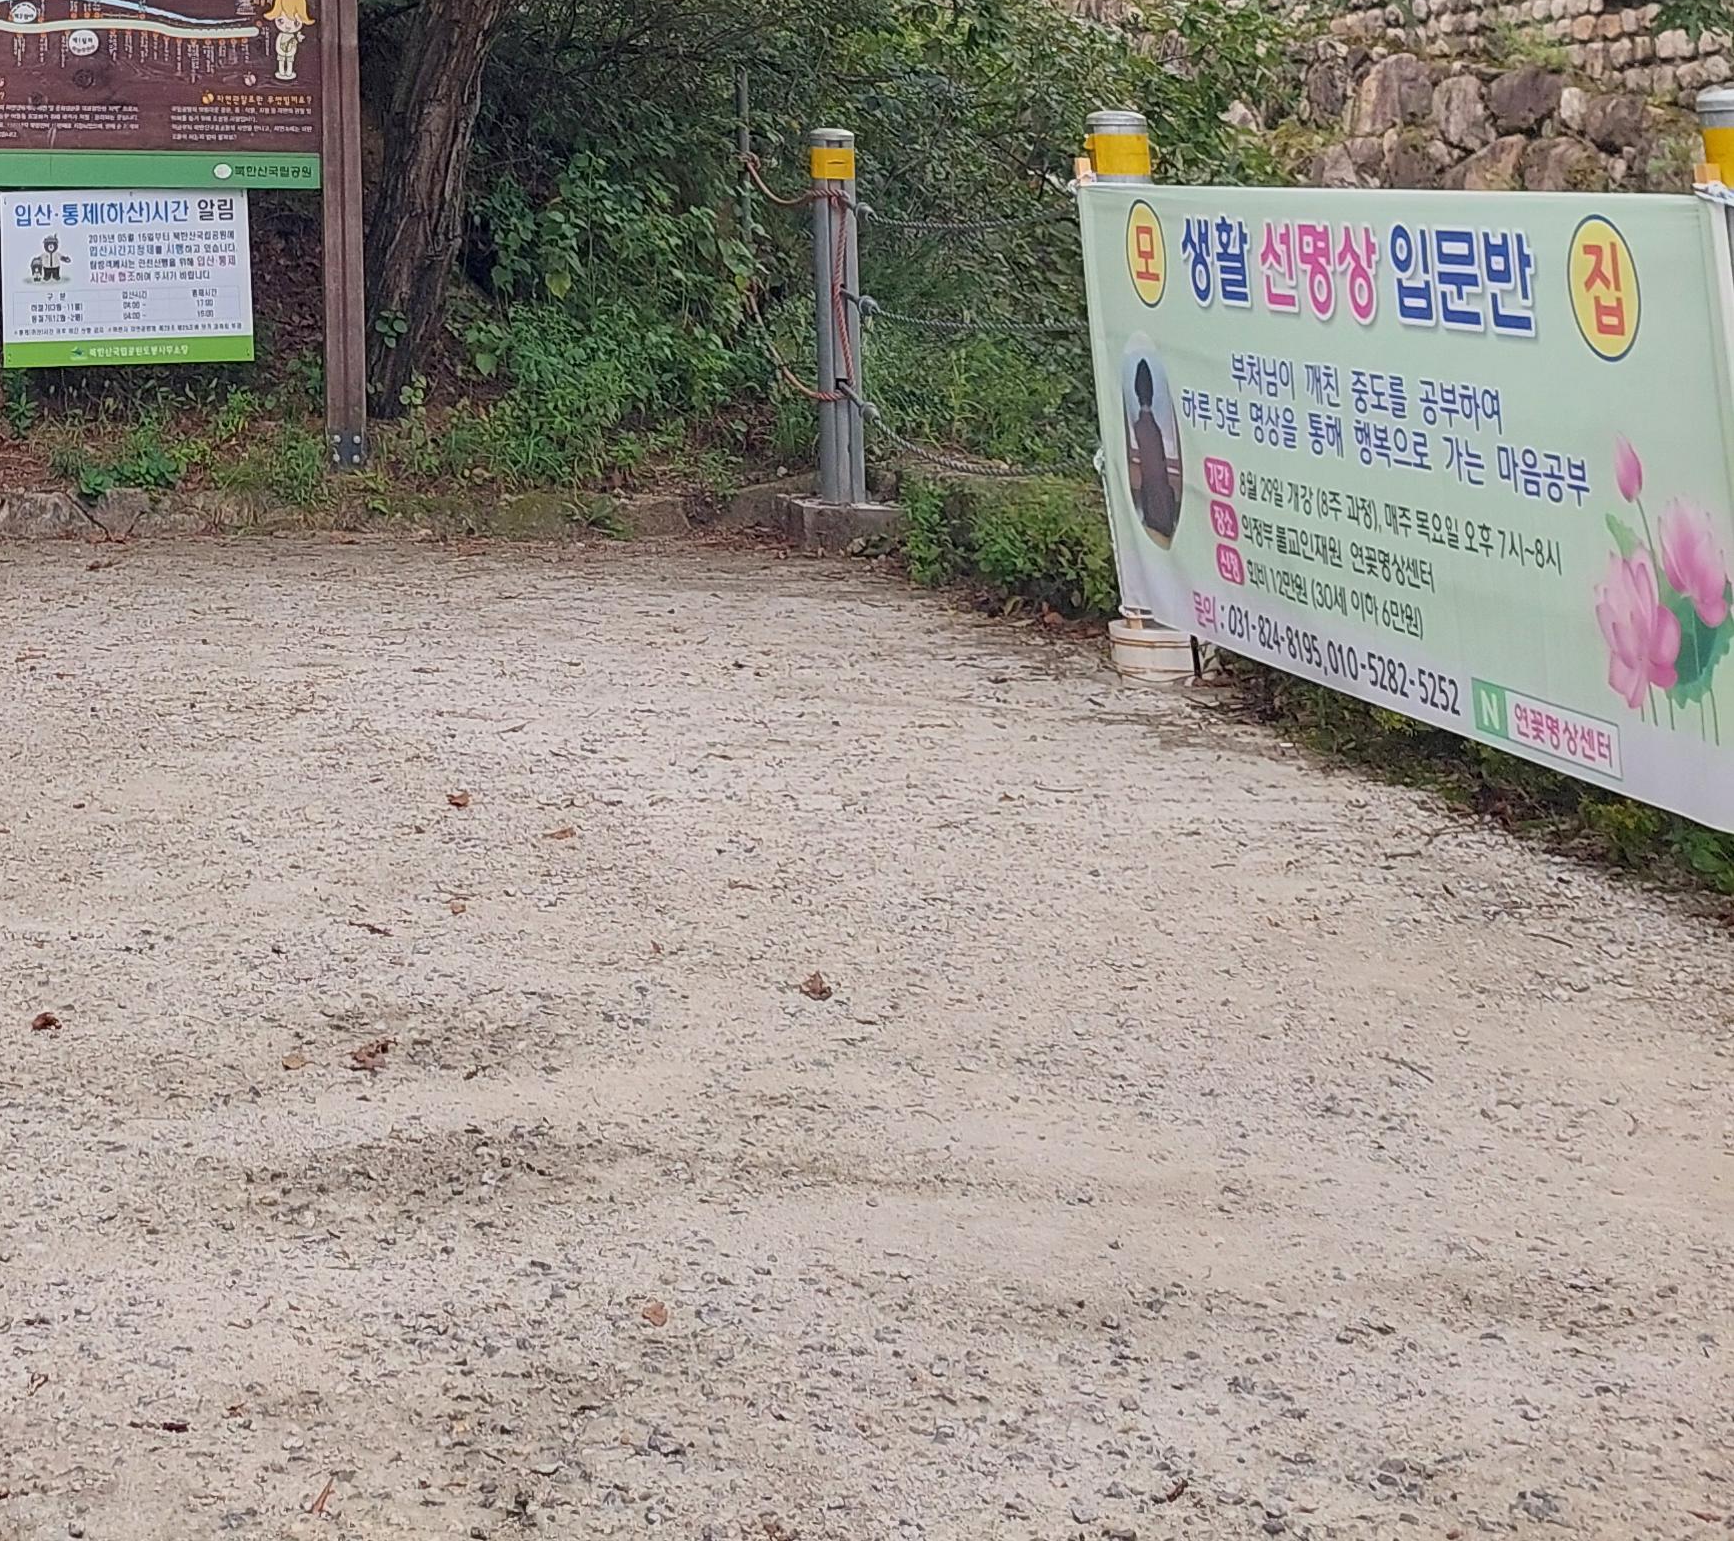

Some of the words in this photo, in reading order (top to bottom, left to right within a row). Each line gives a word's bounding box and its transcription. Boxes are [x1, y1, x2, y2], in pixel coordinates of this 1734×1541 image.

[235, 165, 312, 178] 북한산국립공원
[197, 198, 234, 221] 알림
[1135, 224, 1161, 283] 모
[1181, 215, 1250, 304] 생활
[1260, 221, 1378, 323] 선명상
[1389, 223, 1535, 334] 입문반
[1582, 240, 1627, 338] 집
[1231, 352, 1296, 401] 부처님이
[1304, 363, 1342, 409] 깨친
[1351, 370, 1408, 419] 중도를
[1419, 380, 1503, 435] 공부하여
[1181, 388, 1213, 433] 하루
[1215, 397, 1240, 438] 5분
[1249, 402, 1298, 450] 명상을
[1307, 412, 1345, 459] 통해
[1354, 420, 1433, 473] 행복으로
[1442, 436, 1486, 487] 가는
[1496, 444, 1591, 508] 마음공부
[1206, 462, 1230, 495] 기간
[1239, 470, 1257, 501] 8월
[1260, 476, 1284, 508] 29일
[1287, 482, 1314, 516] 개강
[1384, 502, 1412, 538] 매주
[1416, 510, 1460, 550] 목요일
[1465, 520, 1494, 558] 오후
[1213, 505, 1236, 537] 장소
[1350, 542, 1435, 593] 연꽃명상센터
[1192, 589, 1218, 633] 문의
[1268, 567, 1309, 605] 12만원
[1350, 590, 1378, 626] 이하
[1481, 692, 1502, 731] N
[1514, 702, 1613, 768] 연꽃명상센터
